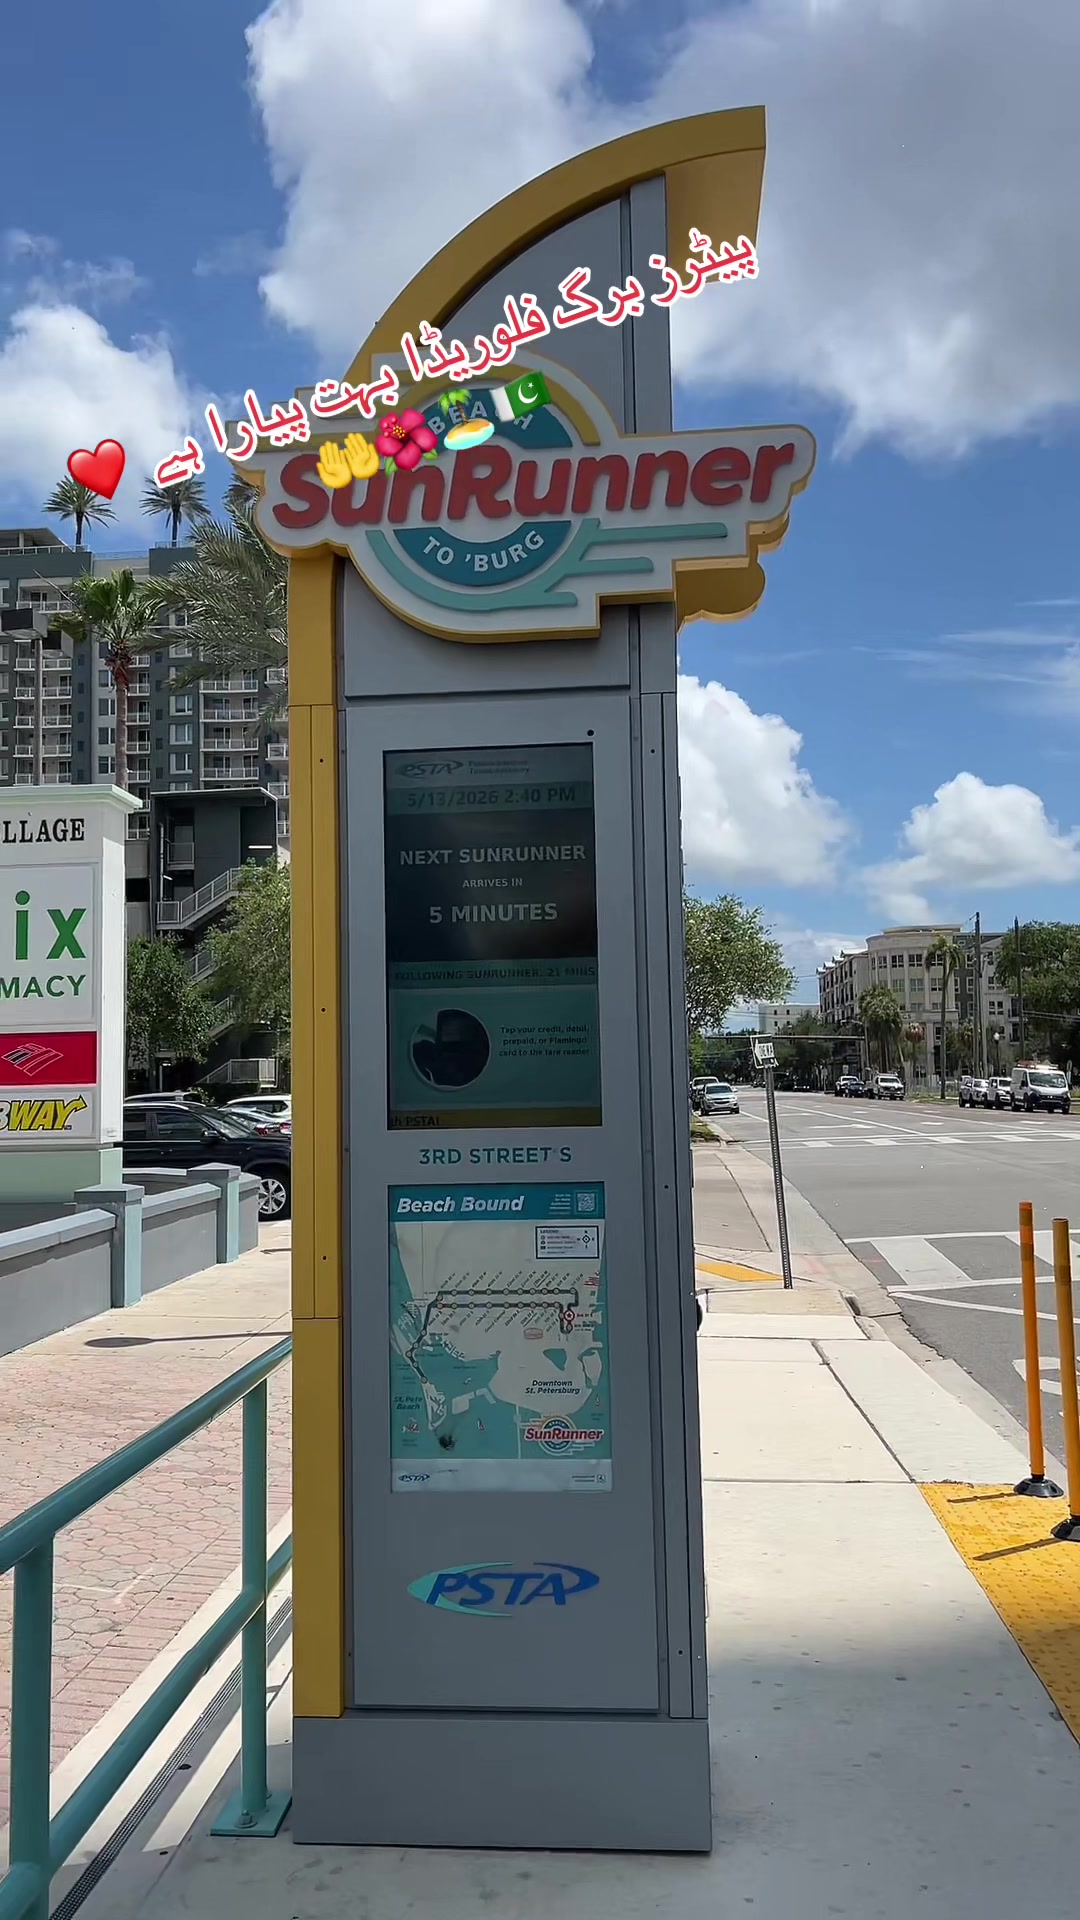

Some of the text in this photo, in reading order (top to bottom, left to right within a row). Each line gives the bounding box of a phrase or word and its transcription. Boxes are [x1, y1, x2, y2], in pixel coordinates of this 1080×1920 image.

[427, 400, 534, 435] BEAH
[272, 441, 796, 529] SunRunner
[423, 536, 455, 565] TO
[407, 787, 575, 808] 5/13/2026 2:40 PM
[400, 845, 587, 866] NEXT SUNRUNNER
[462, 878, 523, 888] ARRIVES IN
[429, 903, 558, 924] 5 MINUTES
[15, 890, 87, 960] ix
[517, 1026, 536, 1034] your
[419, 1147, 572, 1165] 3RD STREET S
[397, 1195, 525, 1213] Beach Bound
[532, 1379, 573, 1387] Downtown
[537, 1386, 580, 1395] Petersburg
[525, 1427, 603, 1440] SunRunner
[418, 1568, 582, 1610] PSTA
